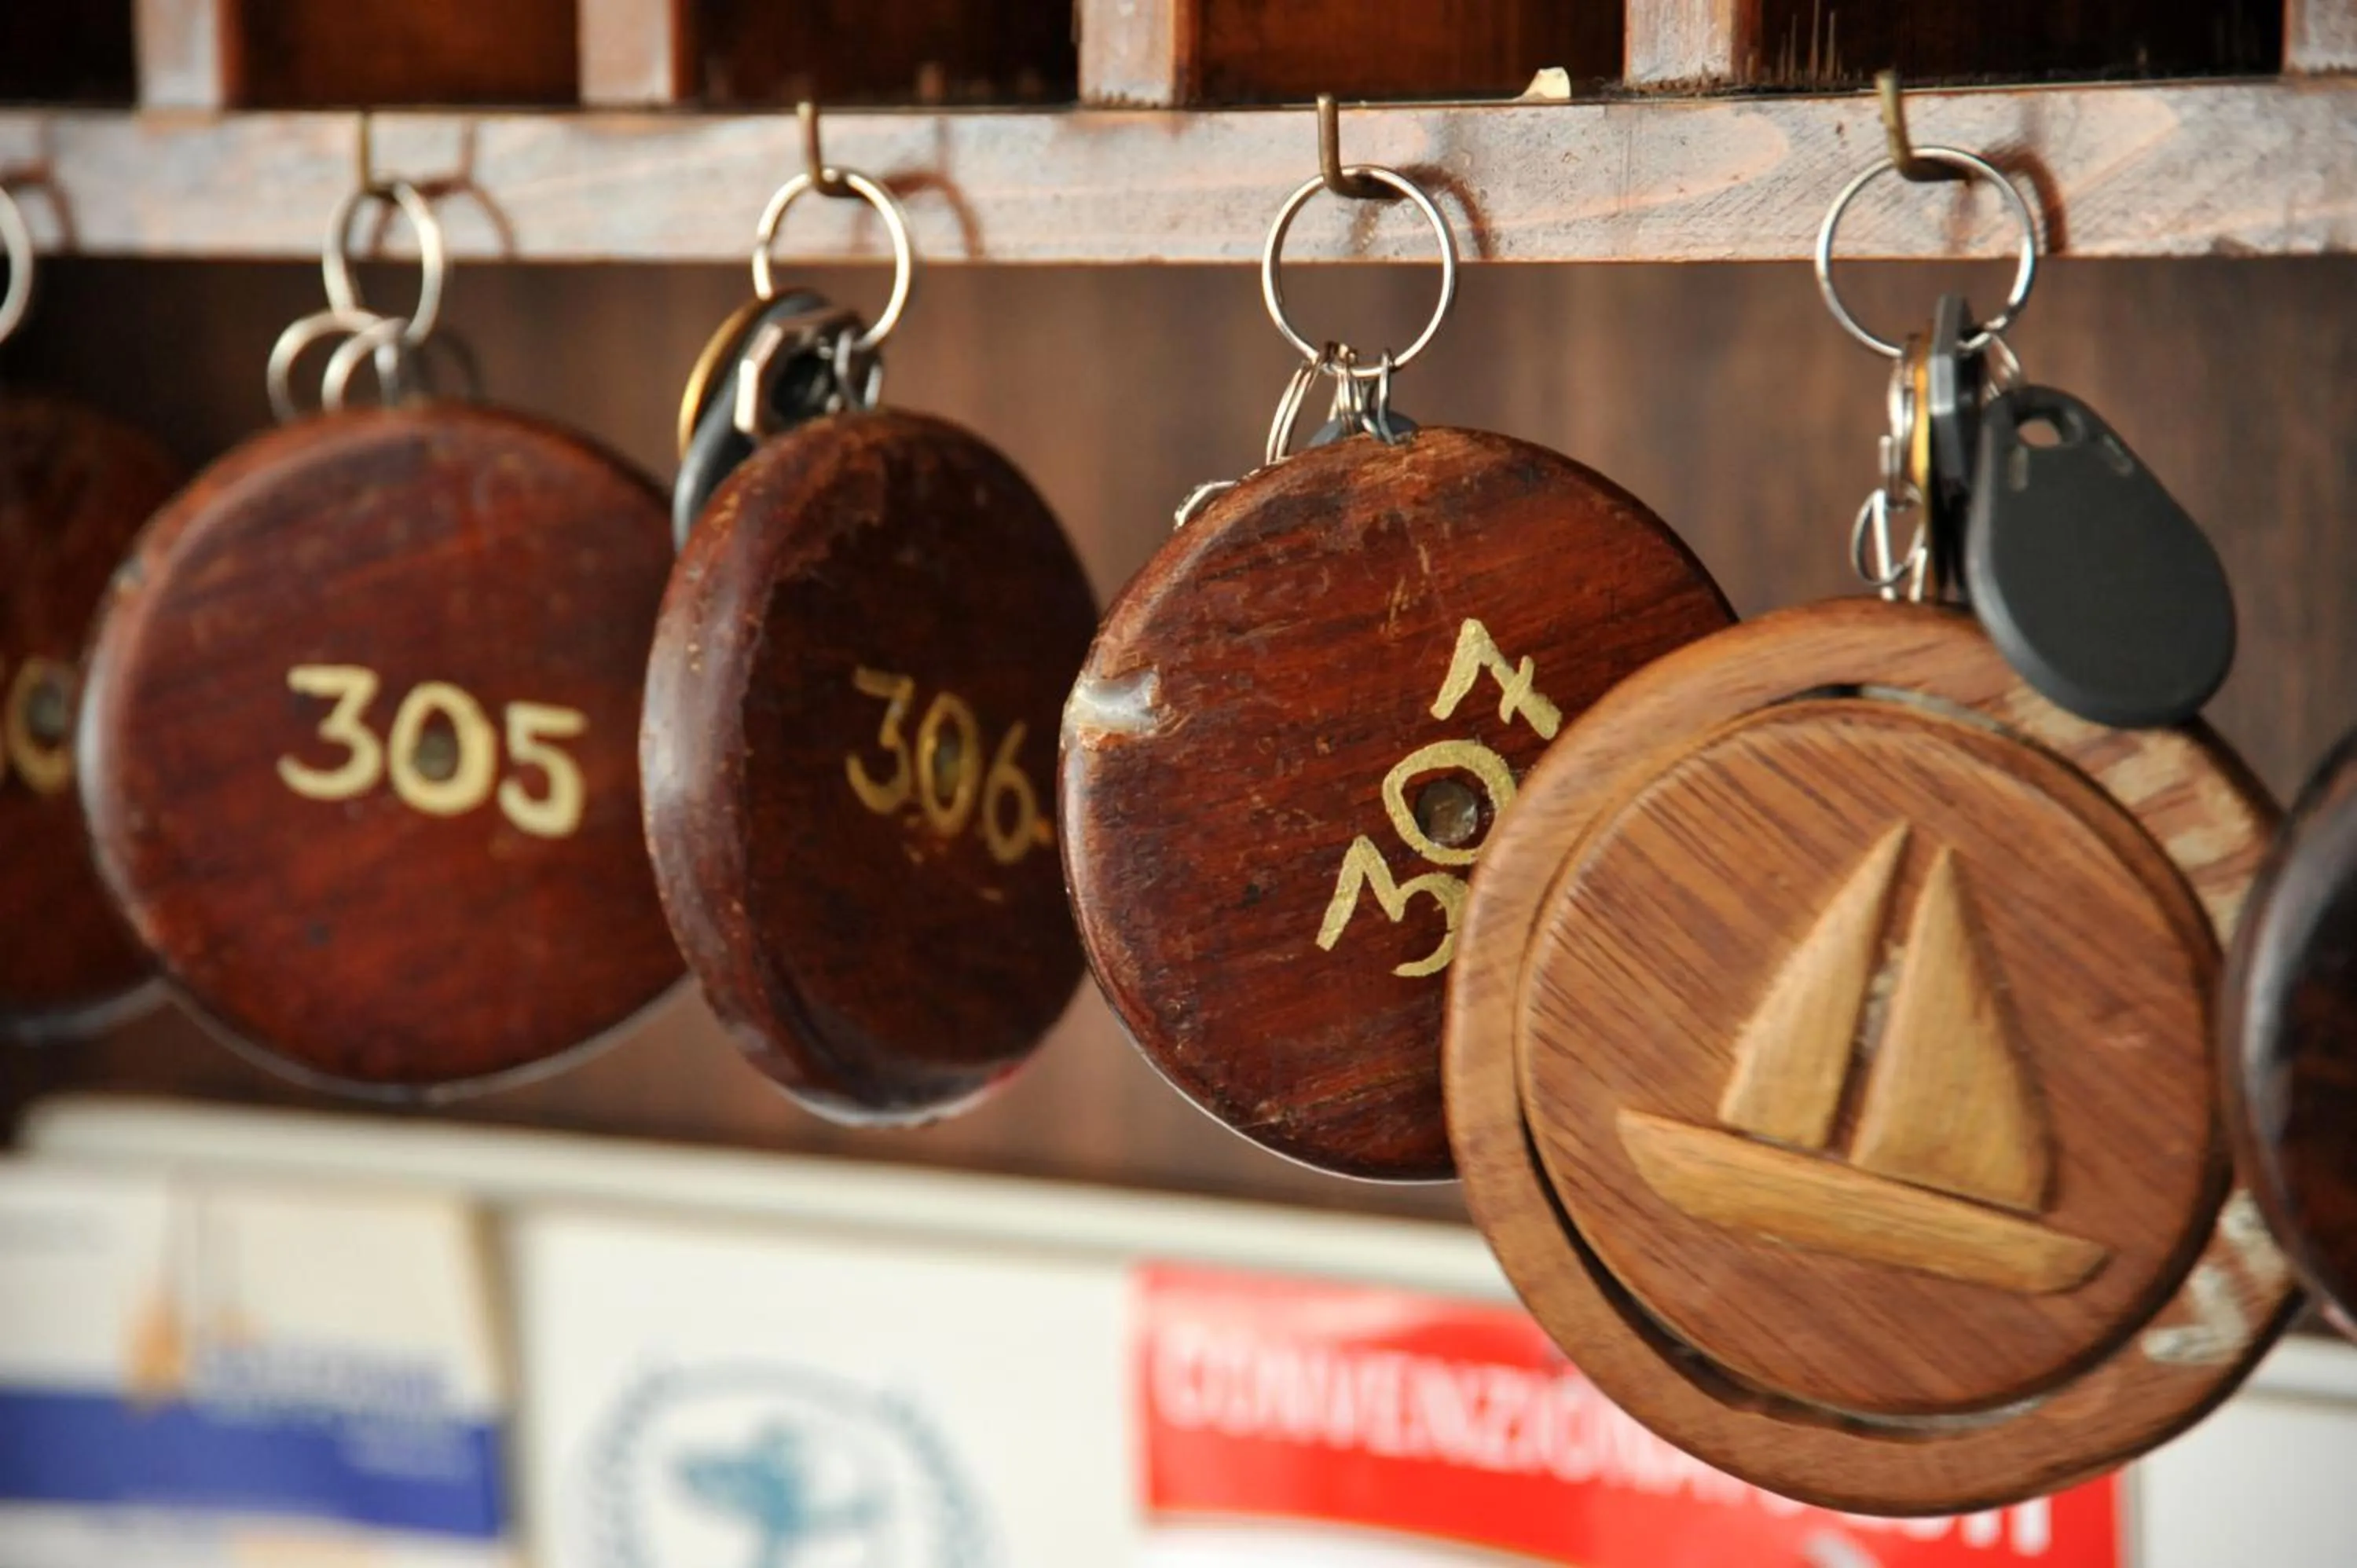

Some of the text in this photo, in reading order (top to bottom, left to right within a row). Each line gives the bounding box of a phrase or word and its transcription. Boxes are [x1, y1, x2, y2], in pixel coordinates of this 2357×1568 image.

[277, 663, 588, 839] 305
[845, 666, 1039, 863] 306
[1315, 617, 1563, 977] 307
